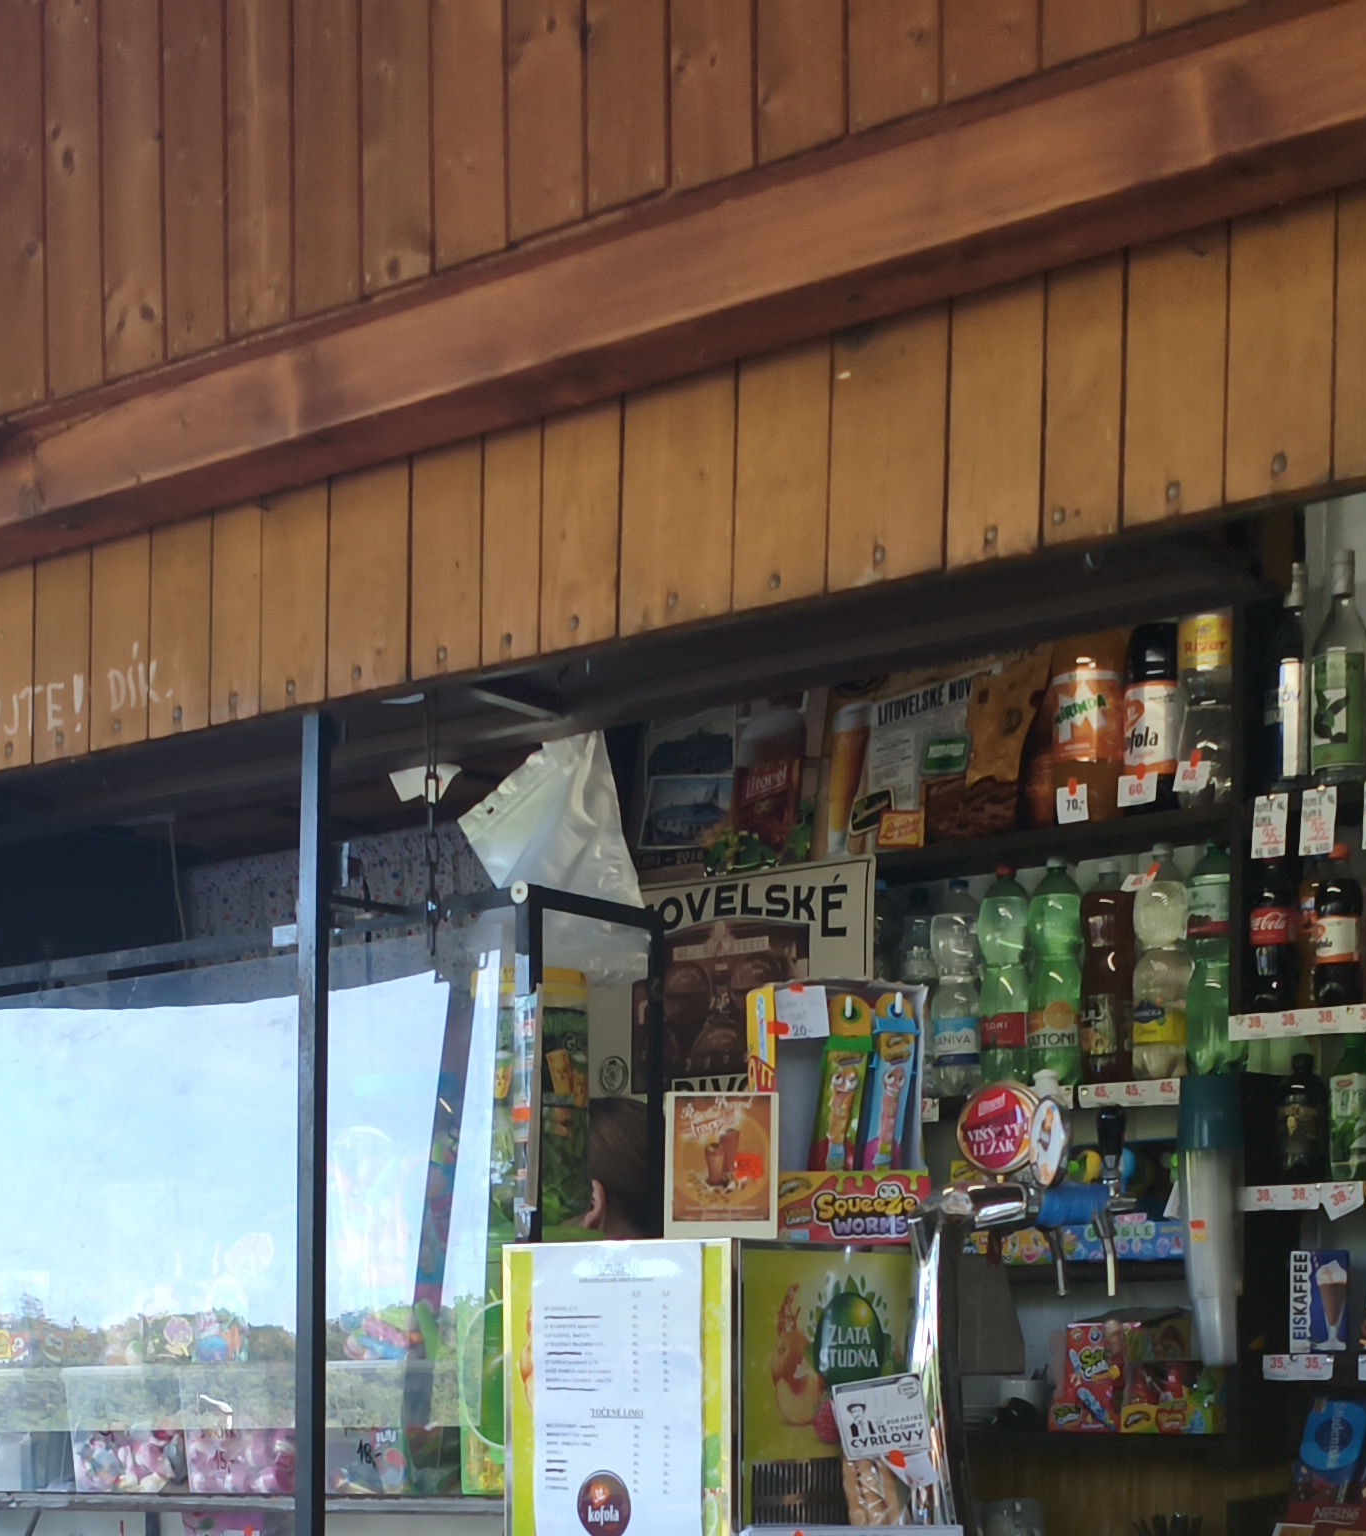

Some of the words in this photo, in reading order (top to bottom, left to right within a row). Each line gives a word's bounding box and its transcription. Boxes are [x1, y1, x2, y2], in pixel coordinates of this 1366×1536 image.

[645, 874, 849, 938] OVELSKÉ
[834, 1217, 908, 1236] WORMS
[1293, 1253, 1308, 1341] EISKAFFEE
[828, 1321, 871, 1348] ZLATÁ
[819, 1343, 879, 1370] STUDŇA
[590, 1406, 621, 1419] TOČENÉ
[622, 1407, 644, 1419] LIMO
[850, 1429, 925, 1449] CYRILOVY
[587, 1504, 620, 1527] kofola
